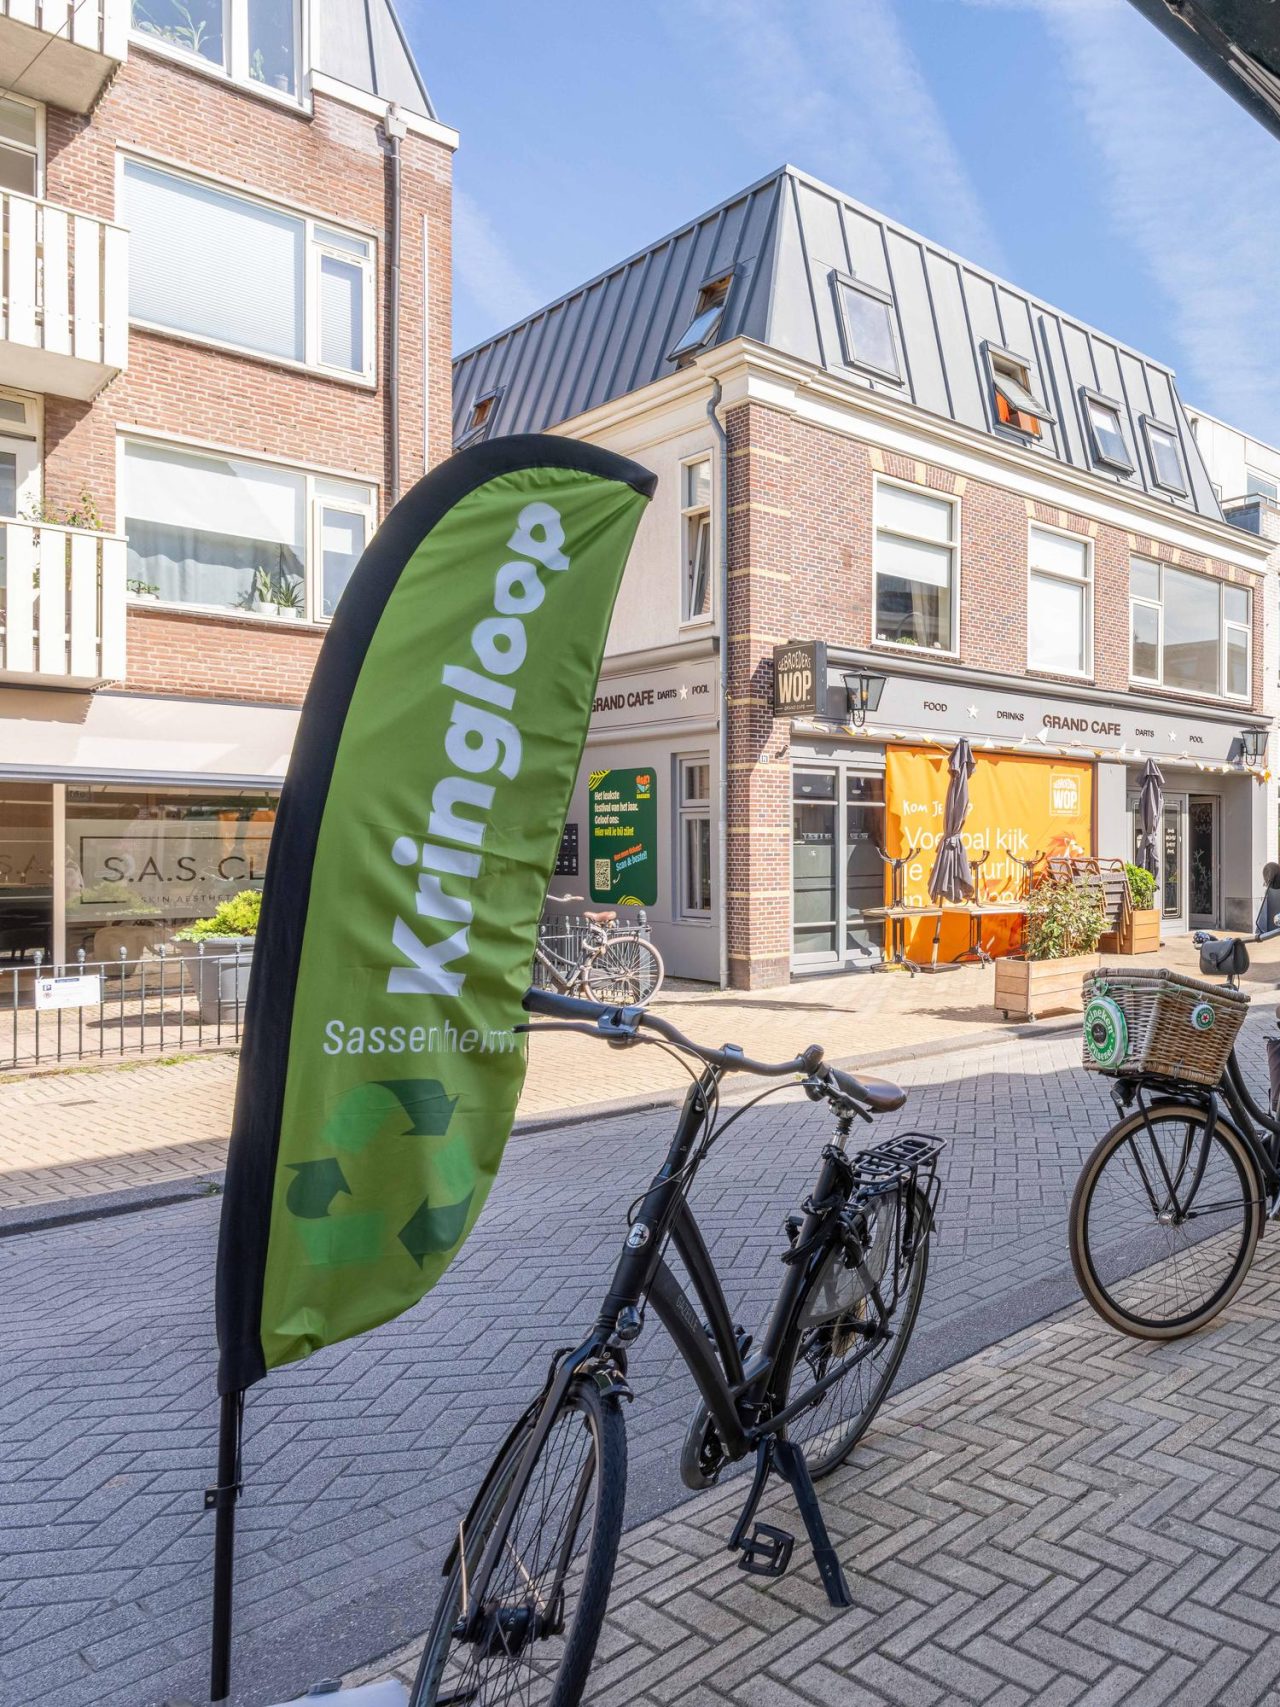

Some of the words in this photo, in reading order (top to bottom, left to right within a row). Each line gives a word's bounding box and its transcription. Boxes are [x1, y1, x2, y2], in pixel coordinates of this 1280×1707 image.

[591, 696, 625, 712] GRAND
[627, 690, 654, 708] CAFE
[657, 689, 677, 700] DARTS
[692, 684, 709, 695] POOL
[778, 670, 812, 703] WOP.
[923, 701, 947, 712] FOOD
[996, 710, 1024, 721] DRINKS
[1042, 714, 1088, 732] GRAND
[1091, 720, 1121, 736] CAFE
[1135, 728, 1155, 738] DARTS
[1189, 735, 1204, 744] POOL
[387, 502, 571, 997] Kringloop
[997, 827, 1029, 855] kijk
[102, 856, 206, 882] S.A.S.
[1085, 1009, 1113, 1034] Heineken
[323, 1019, 515, 1055] Sassenheim
